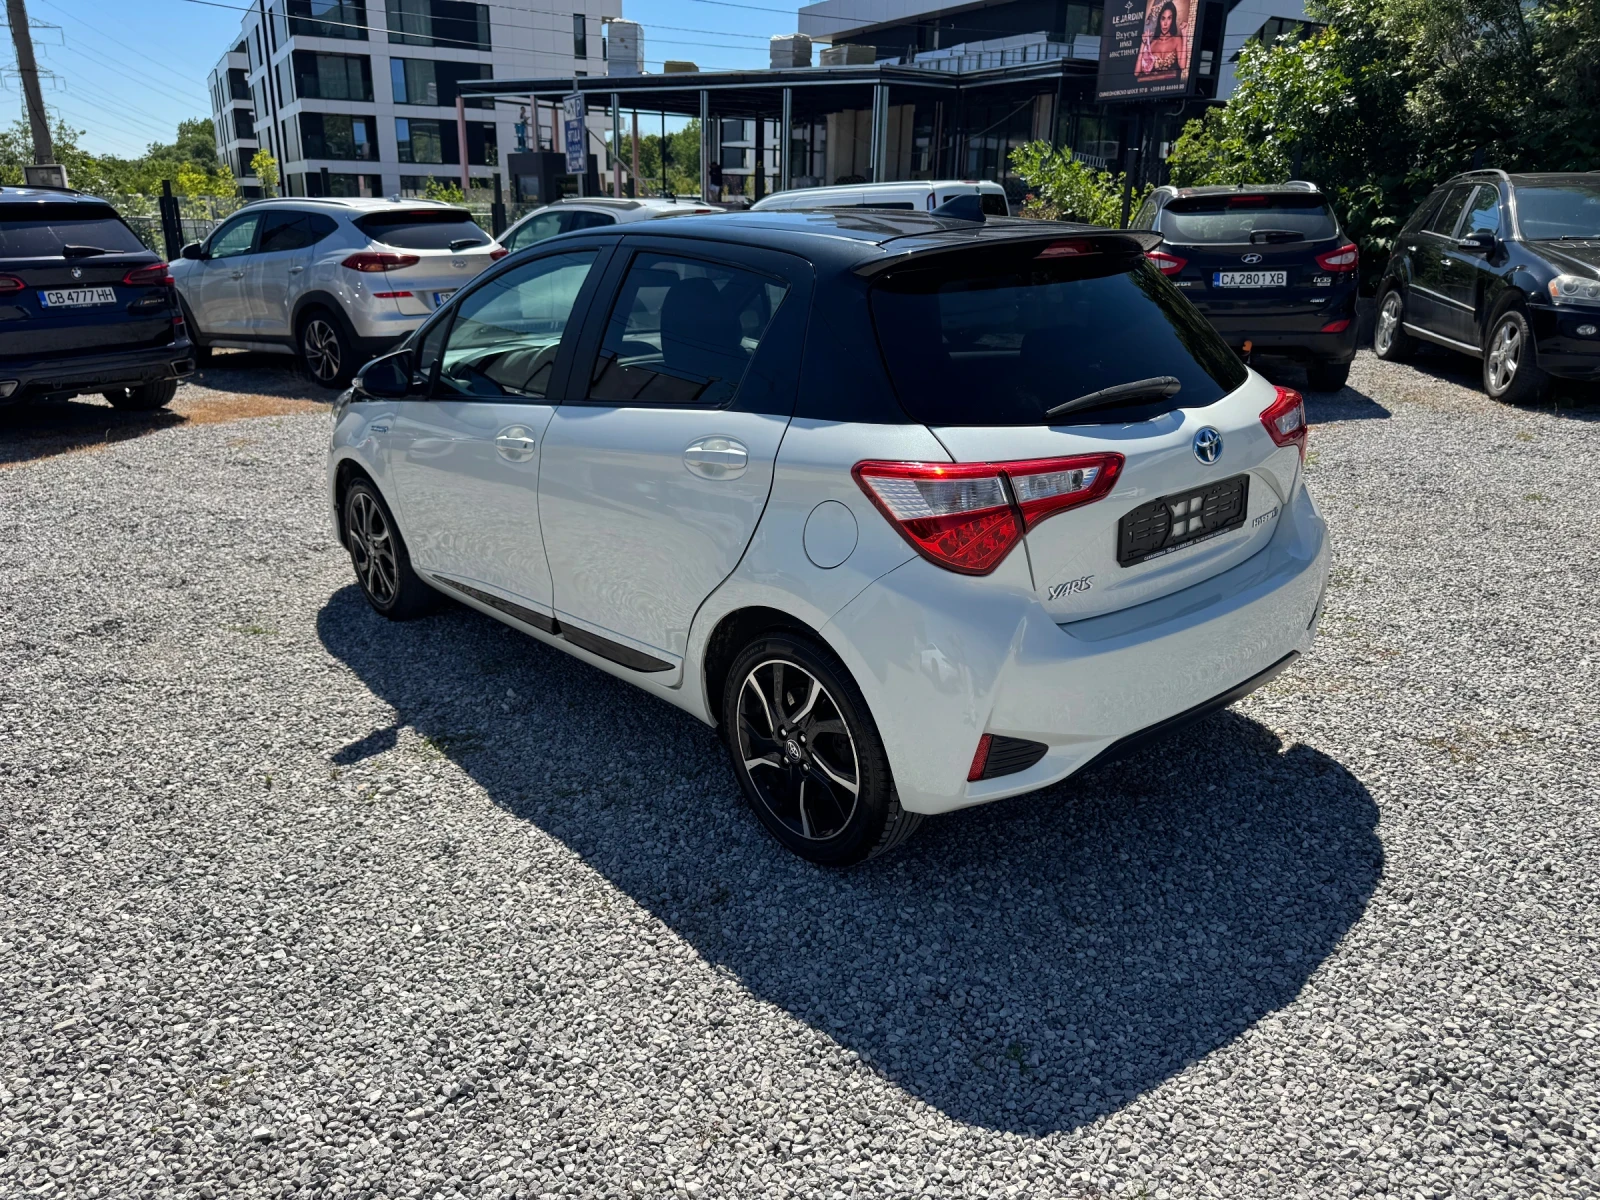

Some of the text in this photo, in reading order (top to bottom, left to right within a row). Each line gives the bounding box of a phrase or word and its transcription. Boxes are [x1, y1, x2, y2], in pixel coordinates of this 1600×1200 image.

[1112, 15, 1120, 24] LE
[1120, 11, 1144, 23] JARDIN
[1115, 30, 1138, 40] Вкусът
[1119, 40, 1132, 48] има
[1109, 47, 1139, 58] инстинкт
[576, 100, 581, 116] P
[1239, 273, 1266, 285] 2801
[1269, 273, 1285, 284] XB
[47, 292, 66, 305] CB
[67, 290, 94, 303] 4777
[96, 288, 114, 301] HH
